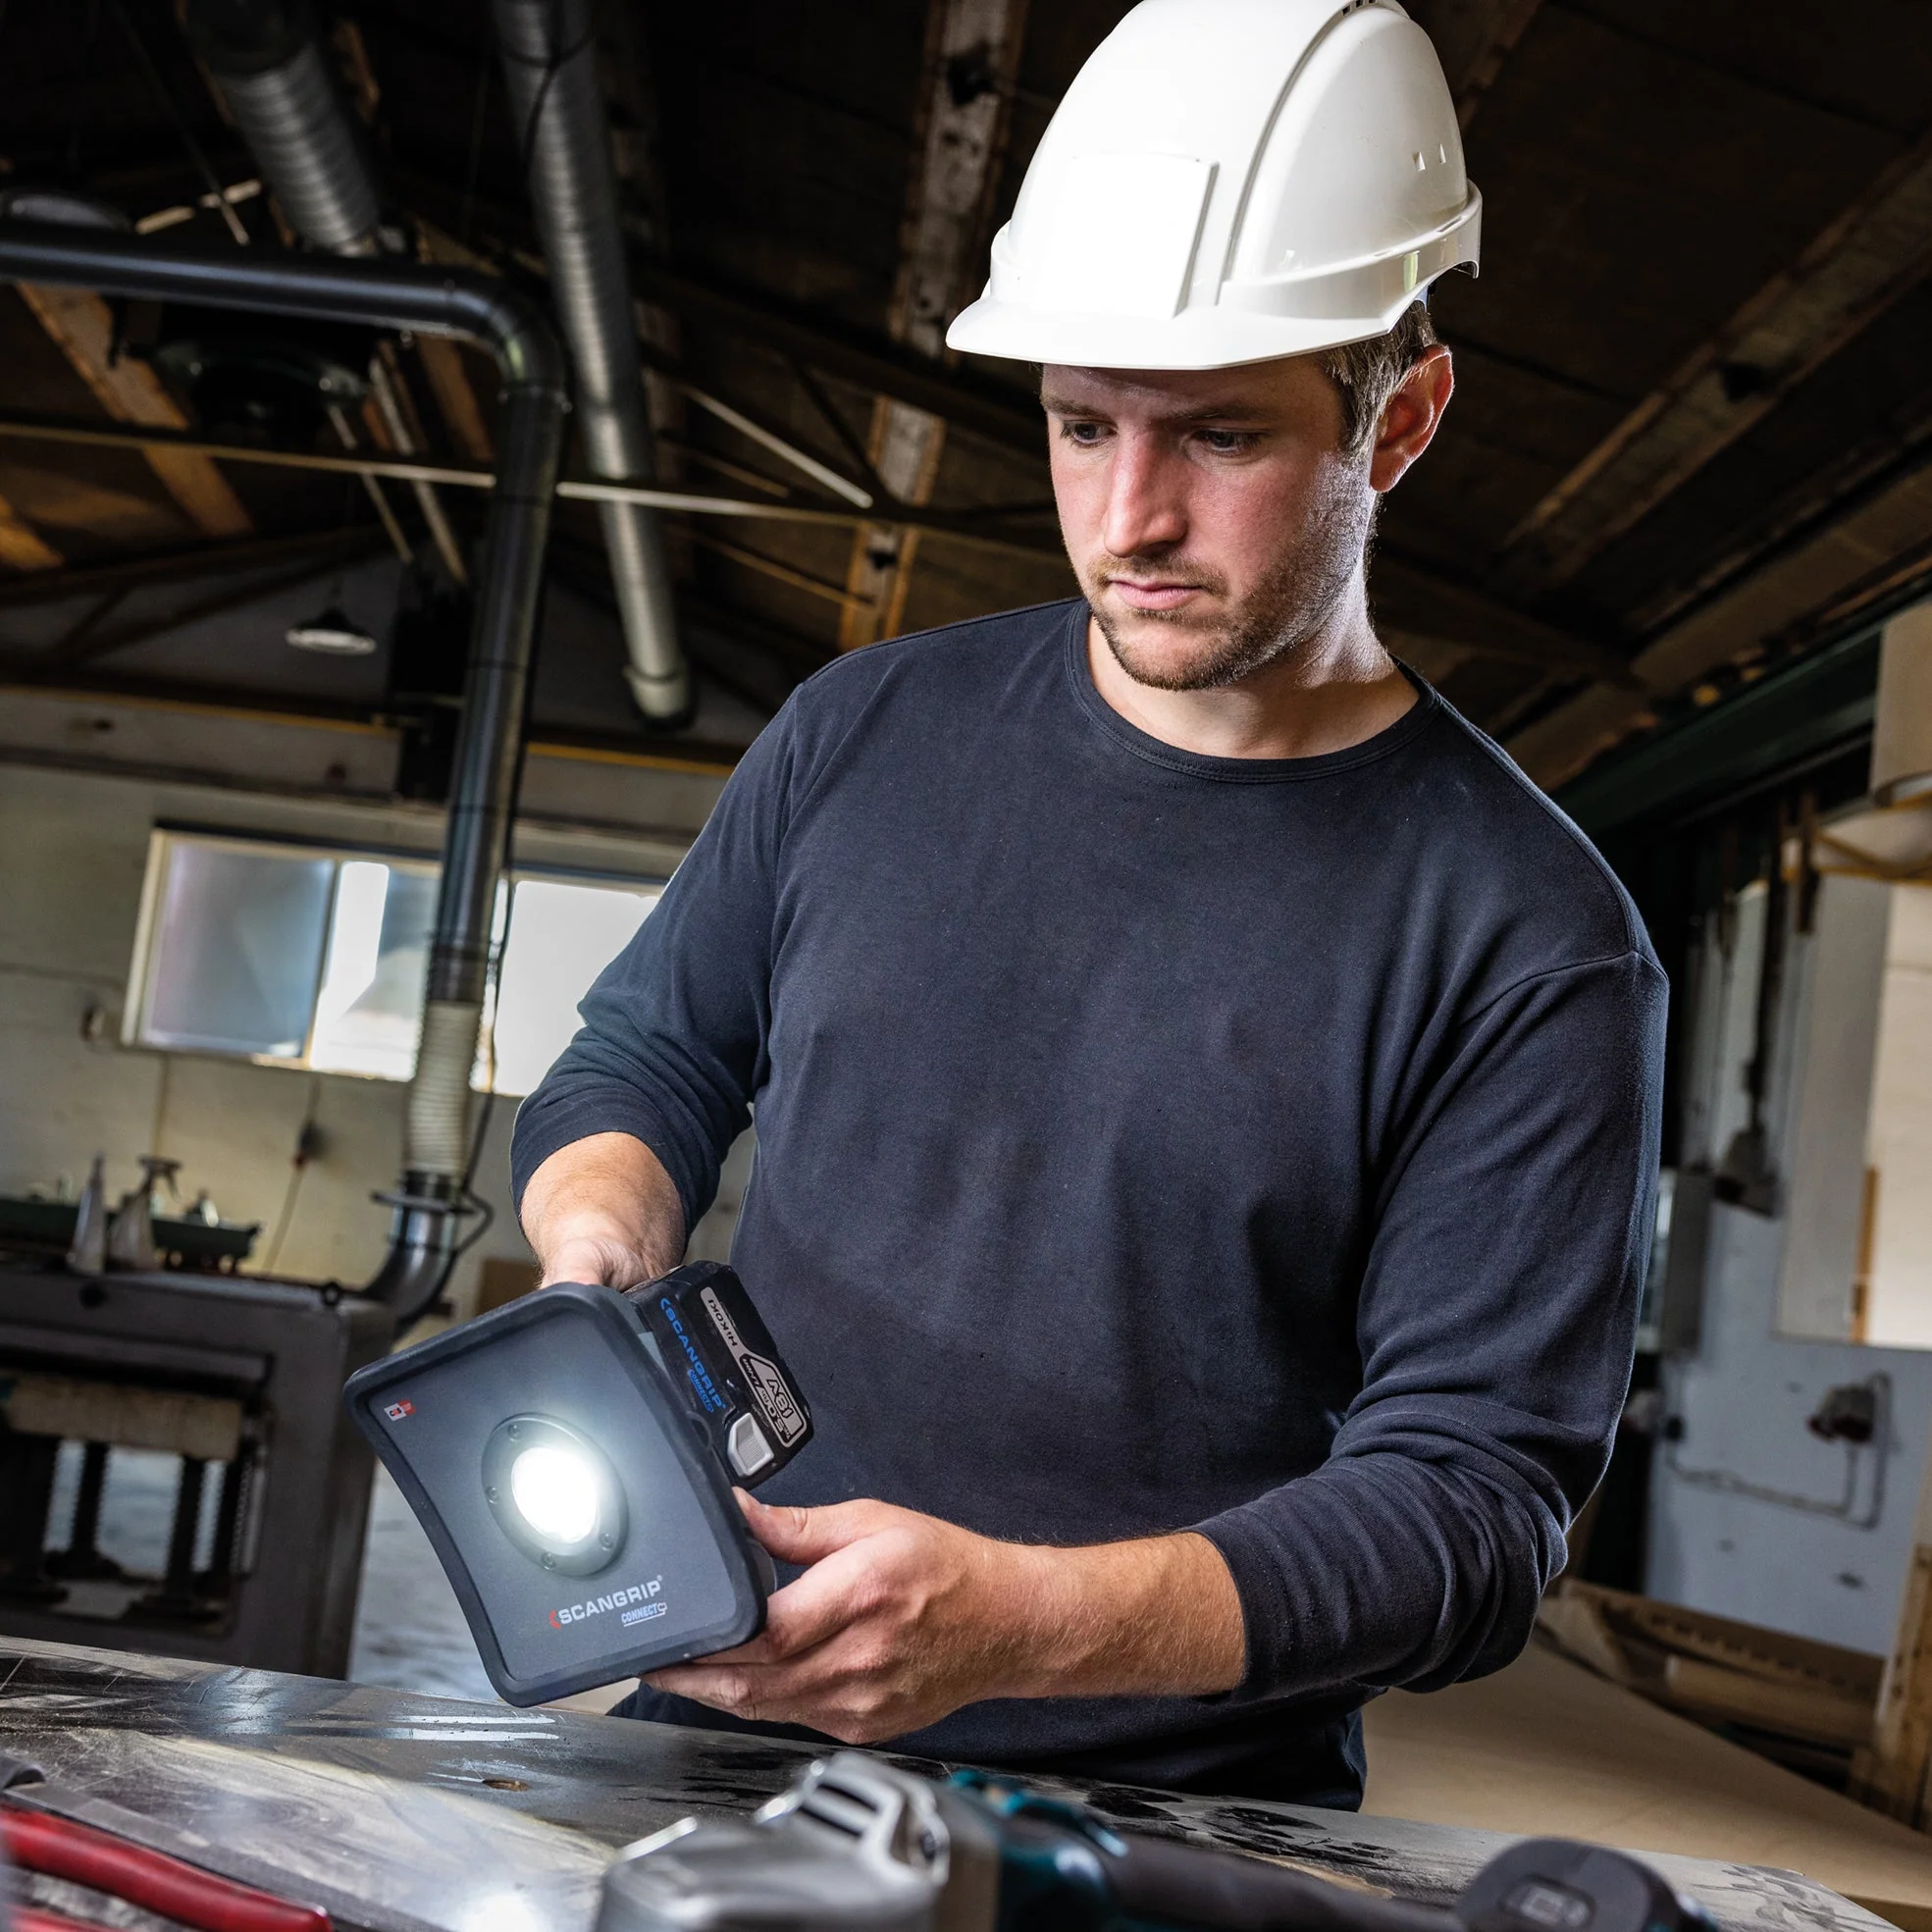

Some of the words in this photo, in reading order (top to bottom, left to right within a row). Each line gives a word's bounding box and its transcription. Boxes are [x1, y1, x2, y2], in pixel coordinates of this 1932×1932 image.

[665, 1306, 723, 1408] SCANGRIP
[557, 1580, 661, 1625] SCANGRIP
[620, 1602, 659, 1624] CONNECT
